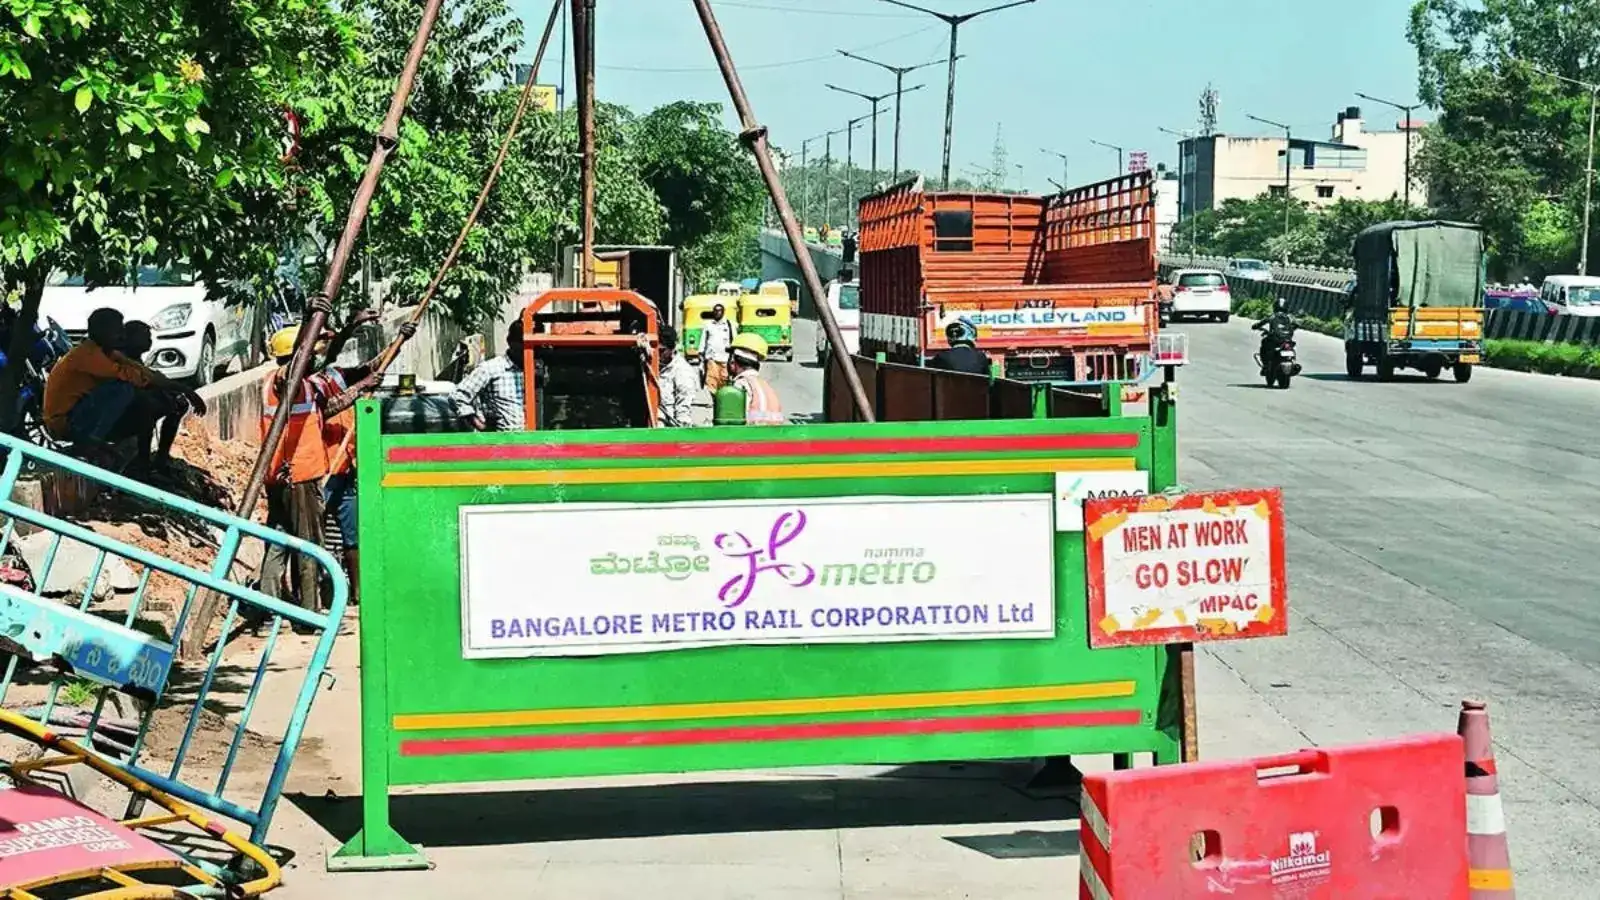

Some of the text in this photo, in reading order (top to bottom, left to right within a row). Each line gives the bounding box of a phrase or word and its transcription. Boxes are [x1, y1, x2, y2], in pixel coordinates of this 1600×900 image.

[1031, 310, 1127, 324] LEYLAND
[1122, 519, 1249, 553] MEN AT WORK
[863, 546, 926, 559] namma
[819, 560, 937, 587] metro
[1135, 557, 1246, 590] GO SLOW
[1199, 592, 1258, 614] MPAC
[490, 601, 1035, 639] BANGALORE METRO RAIL CORPORATION Ltd
[1270, 849, 1331, 873] Nilkamal
